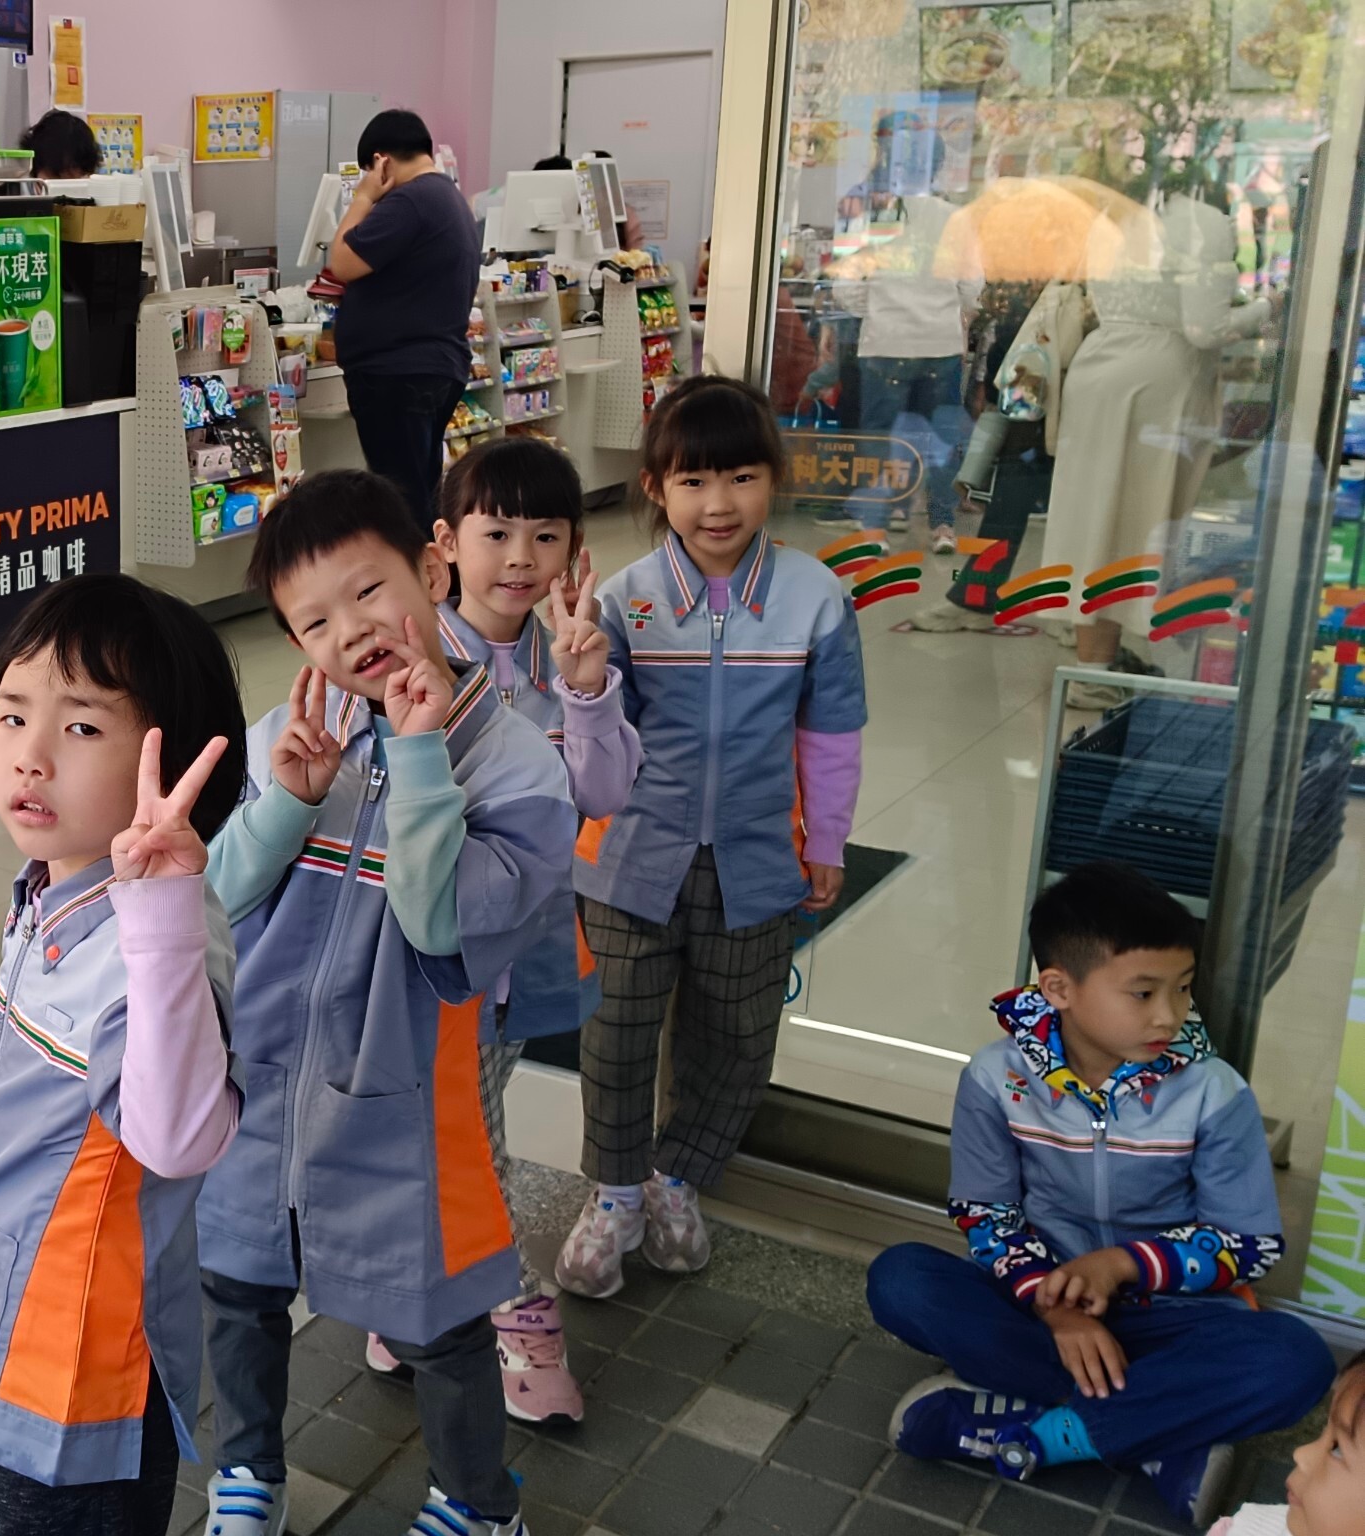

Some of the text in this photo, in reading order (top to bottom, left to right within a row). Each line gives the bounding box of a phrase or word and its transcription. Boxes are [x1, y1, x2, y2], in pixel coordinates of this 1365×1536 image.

[792, 453, 912, 489] 科大門市
[31, 491, 110, 535] PRIMA
[516, 1313, 545, 1324] FILA
